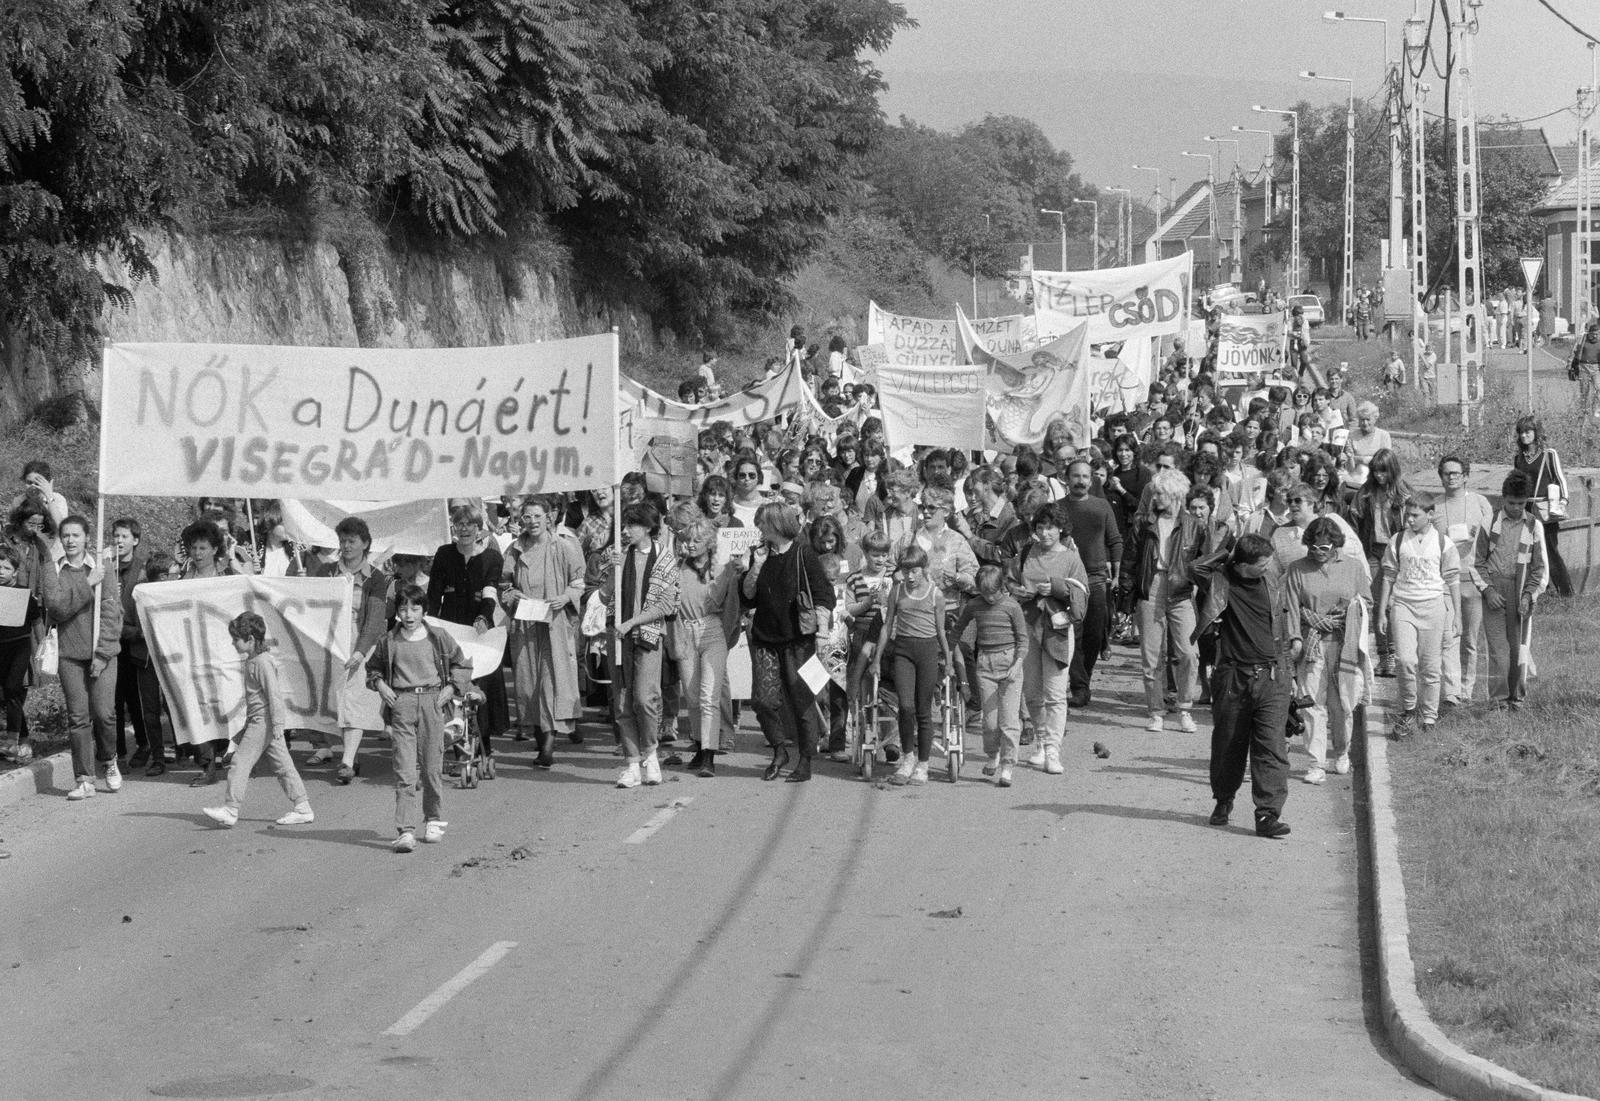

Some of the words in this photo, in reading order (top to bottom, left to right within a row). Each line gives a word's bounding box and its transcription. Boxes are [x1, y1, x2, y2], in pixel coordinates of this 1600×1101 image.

[889, 316, 934, 335] APAD
[939, 323, 949, 335] A
[137, 354, 280, 433] NŐK
[291, 396, 323, 429] a
[343, 363, 593, 437] Dunáért!
